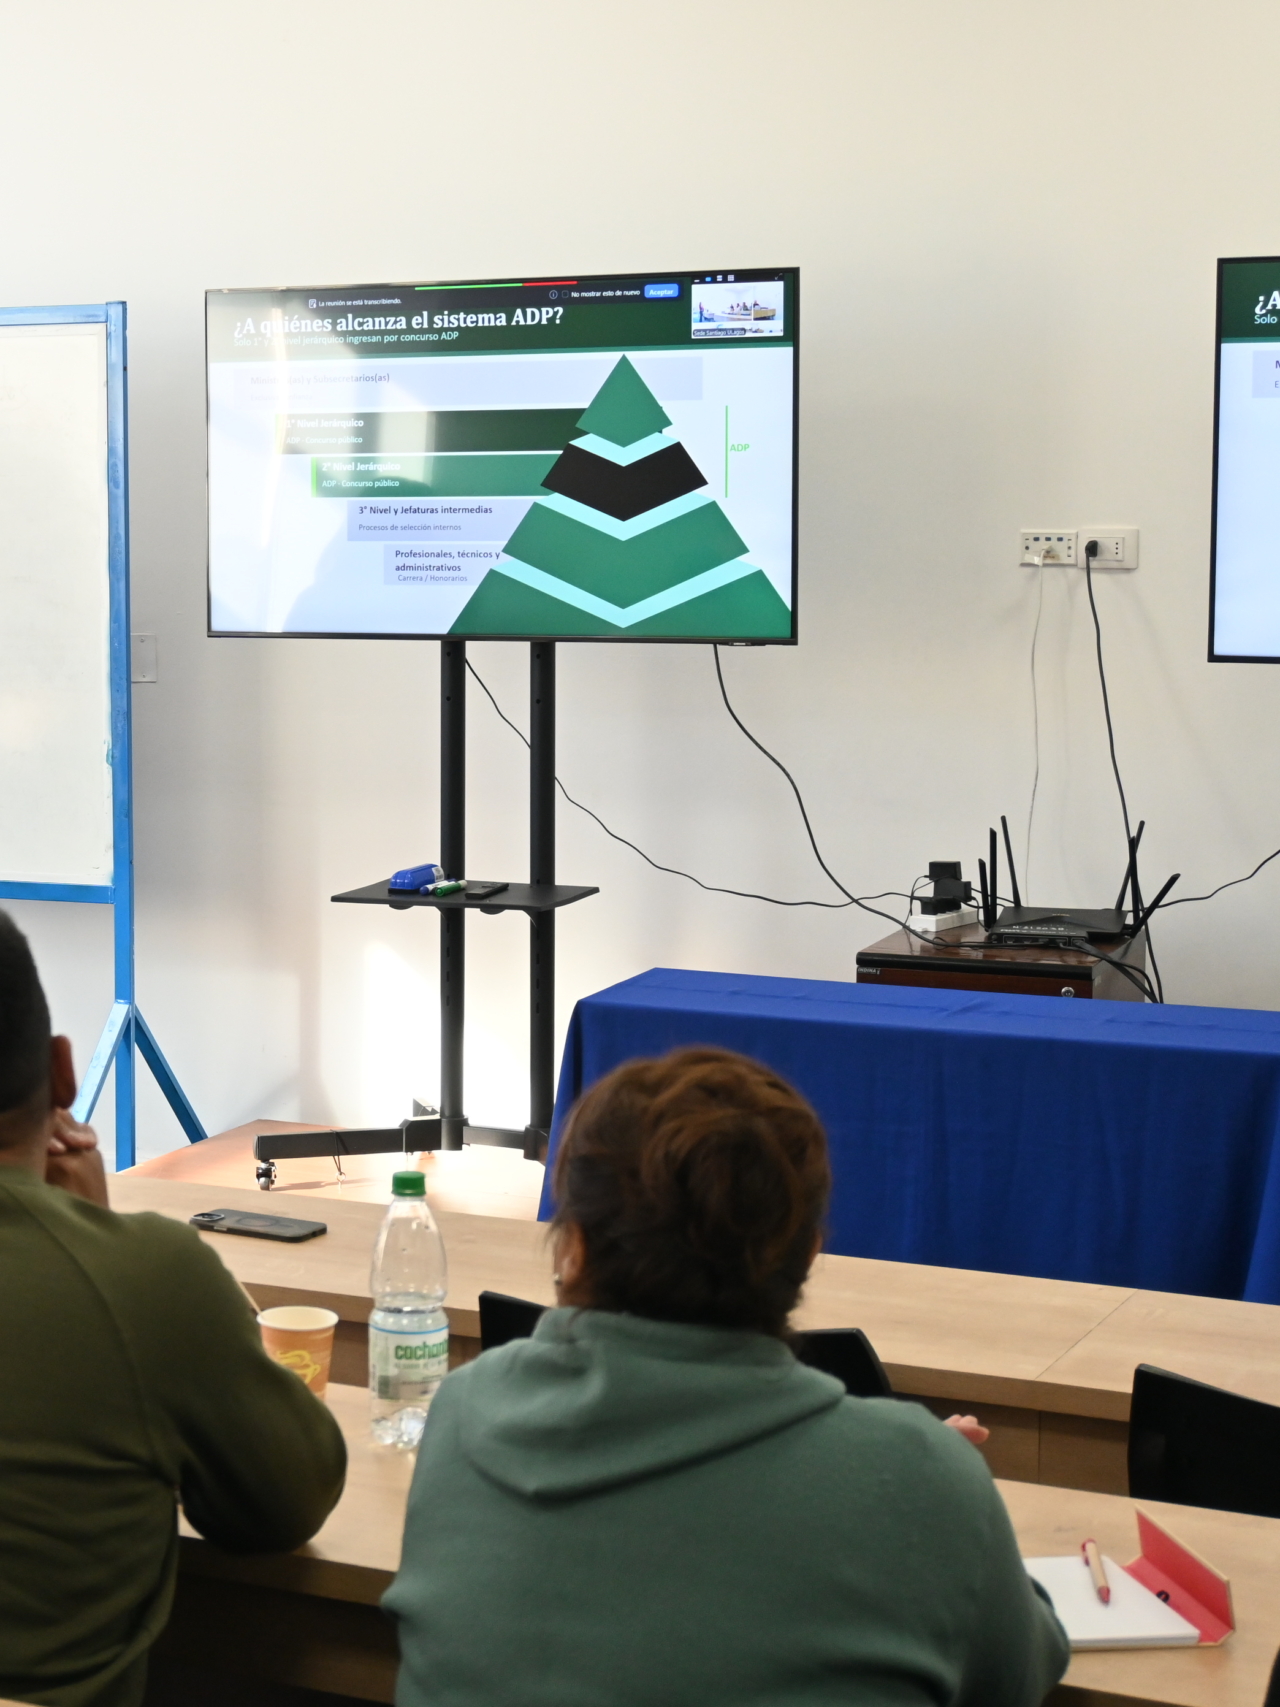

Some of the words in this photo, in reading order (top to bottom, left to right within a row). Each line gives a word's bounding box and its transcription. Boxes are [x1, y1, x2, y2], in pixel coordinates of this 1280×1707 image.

[649, 288, 674, 297] Aceptar
[234, 317, 256, 338] ¿A
[260, 314, 332, 338] quiénes
[336, 312, 407, 332] alcanza
[412, 311, 428, 329] el
[433, 309, 506, 328] sistema
[511, 306, 564, 326] ADP?
[1254, 314, 1278, 324] Solo
[234, 338, 251, 347] Solo
[303, 336, 344, 346] jerárquico
[346, 334, 381, 344] ingresan
[384, 334, 398, 344] por
[401, 332, 439, 342] concurso
[441, 332, 459, 341] ADP
[251, 376, 304, 385] Minists(as)
[297, 419, 318, 428] Nivel
[320, 418, 364, 429] Jerárquico
[338, 436, 363, 445] público
[730, 444, 750, 452] ADP
[333, 462, 355, 471] Nivel
[356, 461, 400, 472] Jerárquico
[375, 479, 399, 489] público
[370, 505, 391, 514] Nivel
[393, 508, 398, 516] y
[400, 505, 438, 515] Jefaturas
[441, 505, 492, 514] intermedias
[395, 549, 455, 560] Profesionales,
[457, 550, 493, 559] técnicos
[495, 552, 500, 561] y
[395, 563, 461, 572] administrativos
